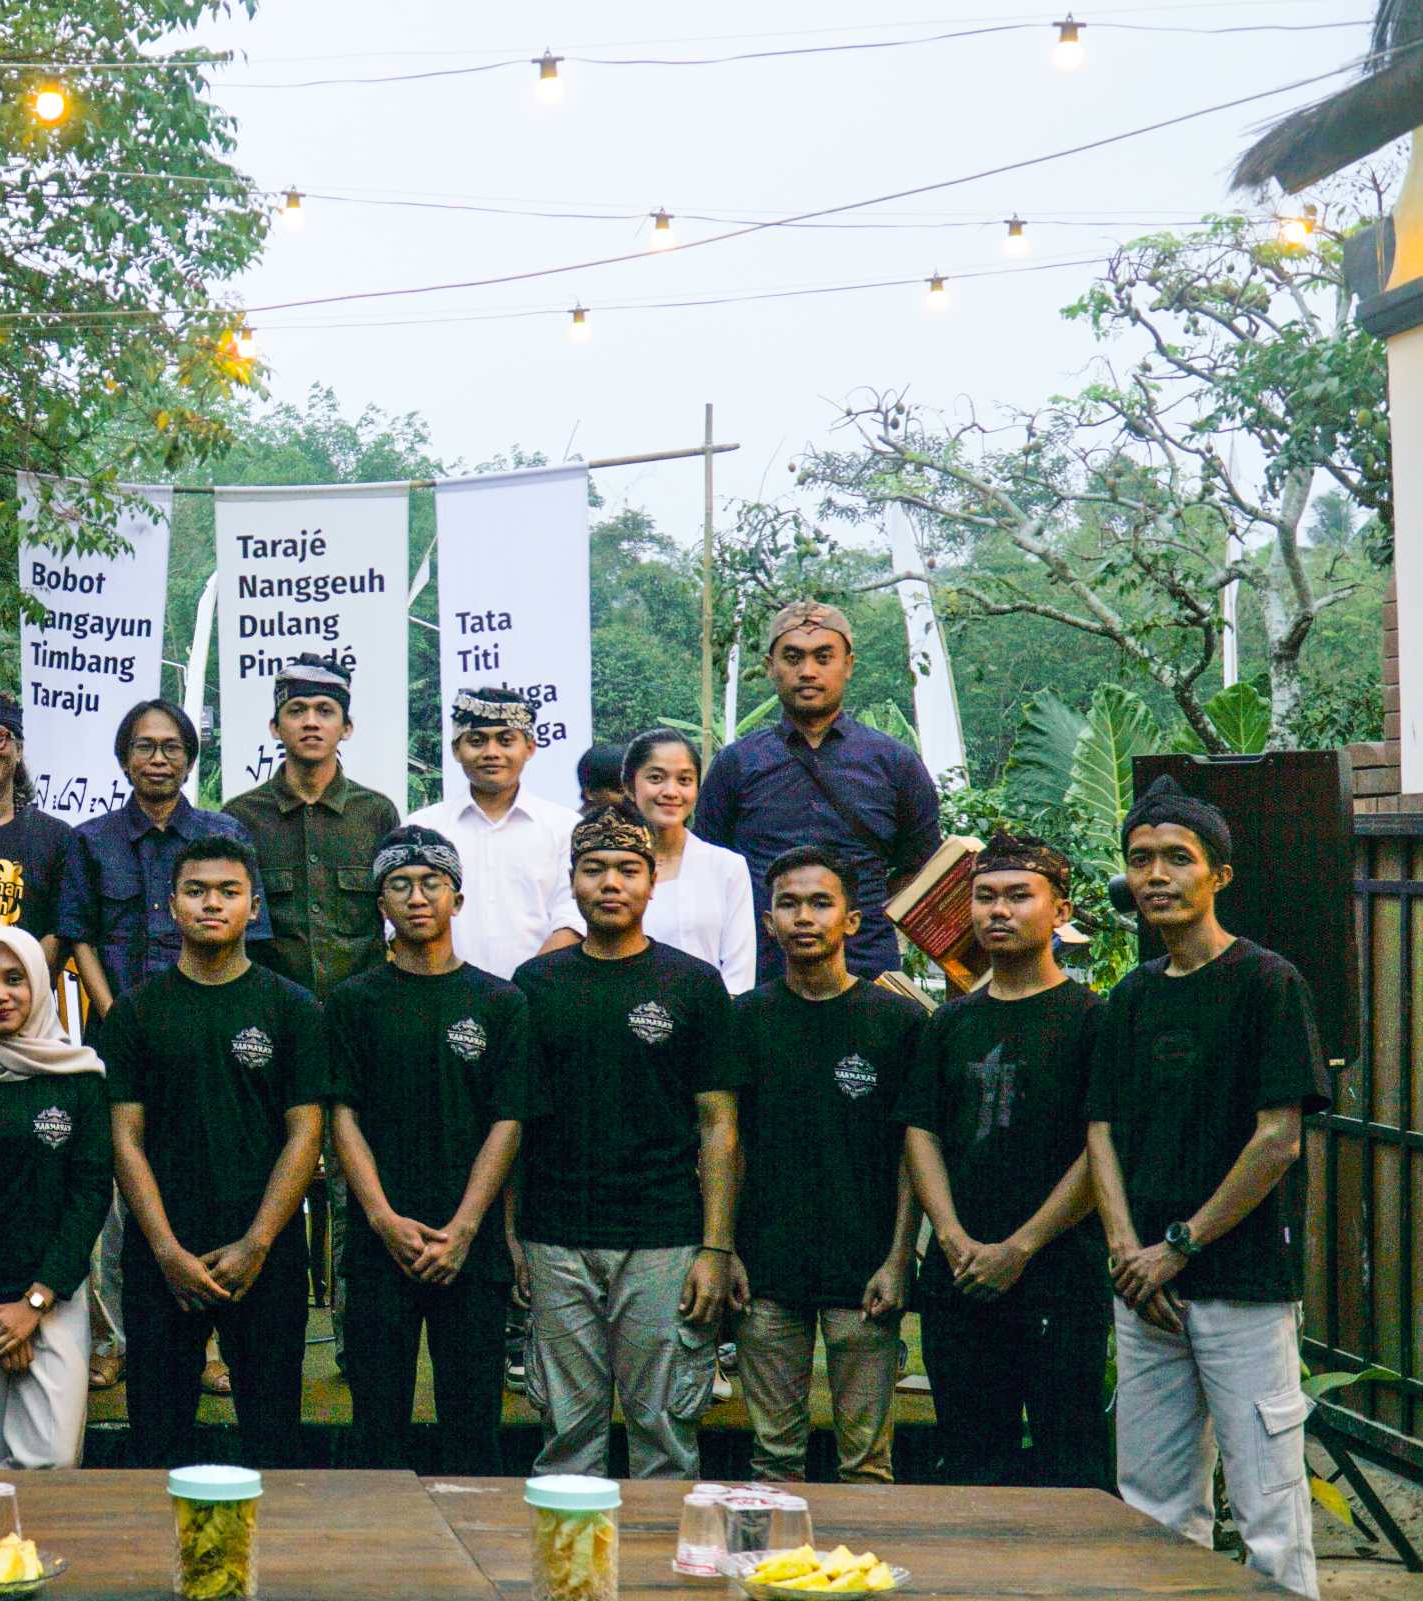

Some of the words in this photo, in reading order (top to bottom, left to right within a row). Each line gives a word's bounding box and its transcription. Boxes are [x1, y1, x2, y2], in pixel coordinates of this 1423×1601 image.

[236, 528, 326, 563] Tarajé
[32, 561, 106, 594] Bobot
[238, 567, 385, 603] Nanggeuh
[30, 609, 152, 641] angayun
[239, 611, 339, 641] Dulang
[455, 610, 512, 635] Tata
[30, 640, 136, 683] Timbang
[457, 642, 499, 673] Titi
[31, 681, 99, 717] Taraju
